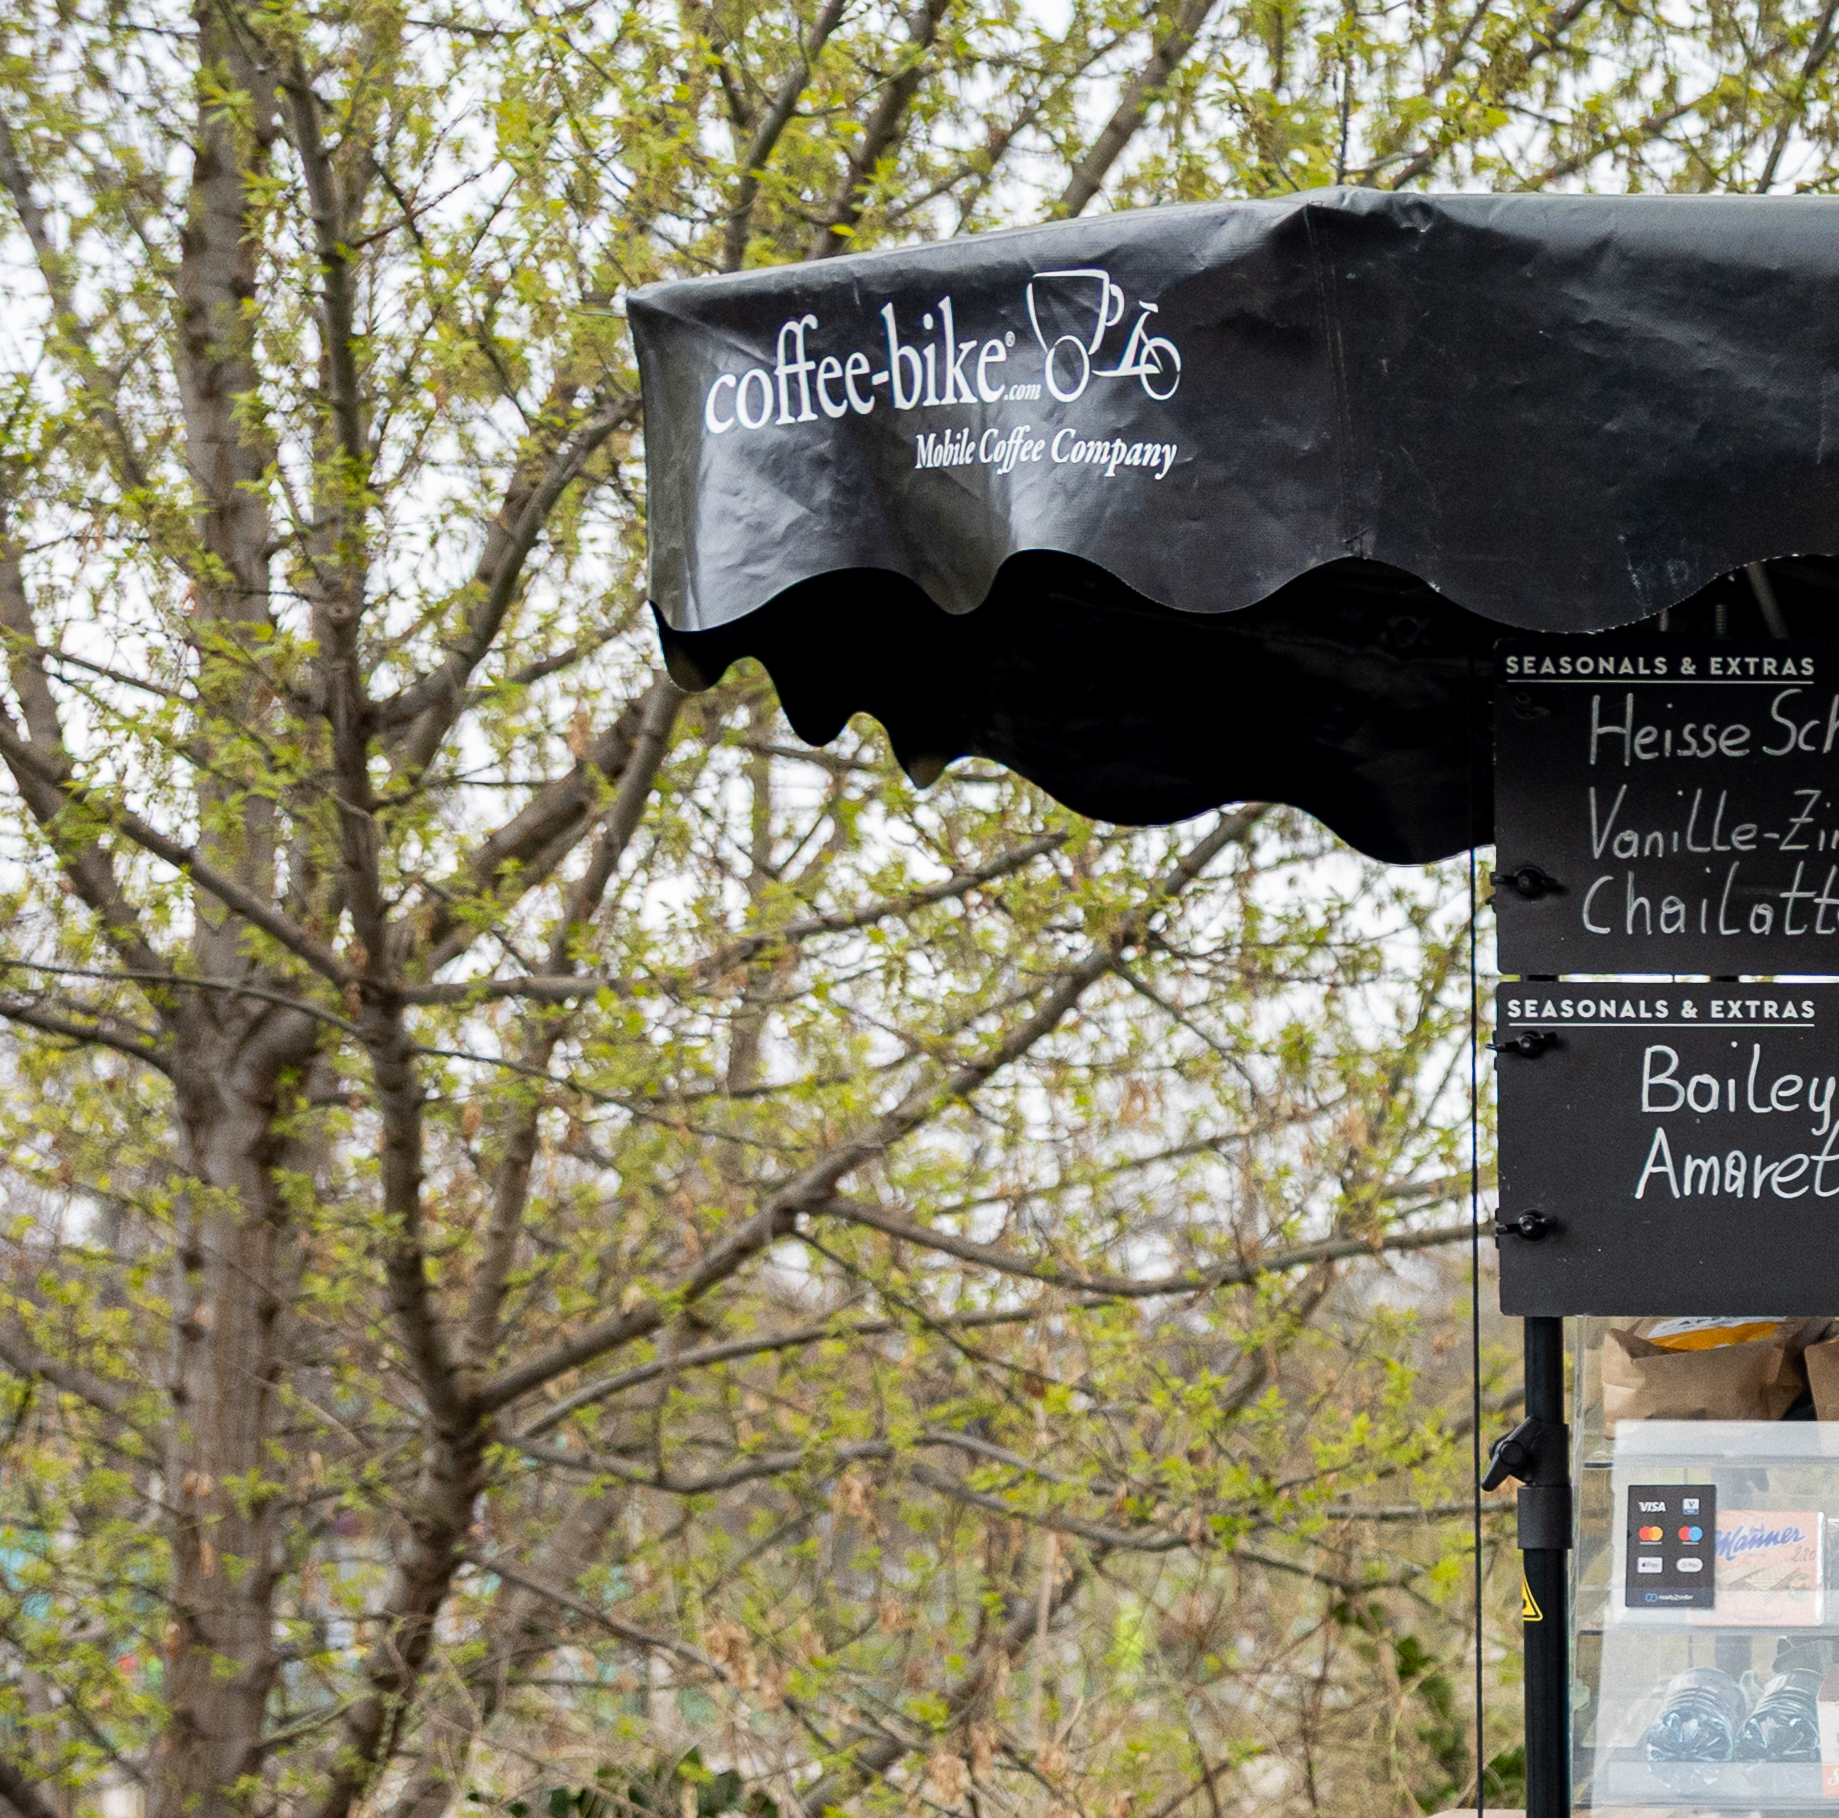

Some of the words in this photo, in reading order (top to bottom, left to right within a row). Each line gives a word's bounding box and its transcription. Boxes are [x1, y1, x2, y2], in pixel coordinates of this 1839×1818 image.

[914, 427, 975, 470] Mobile
[978, 426, 1042, 476] Coffee
[1050, 429, 1178, 478] Company
[1506, 656, 1669, 676] SEASONALS
[1681, 658, 1699, 675] &
[1709, 656, 1815, 676] EXTRAS
[1589, 692, 1750, 766] Heisse
[1508, 1000, 1670, 1019] SEASONALS
[1681, 1001, 1699, 1019] &
[1710, 1000, 1816, 1019] EXTRAS
[1638, 1502, 1666, 1512] VISA
